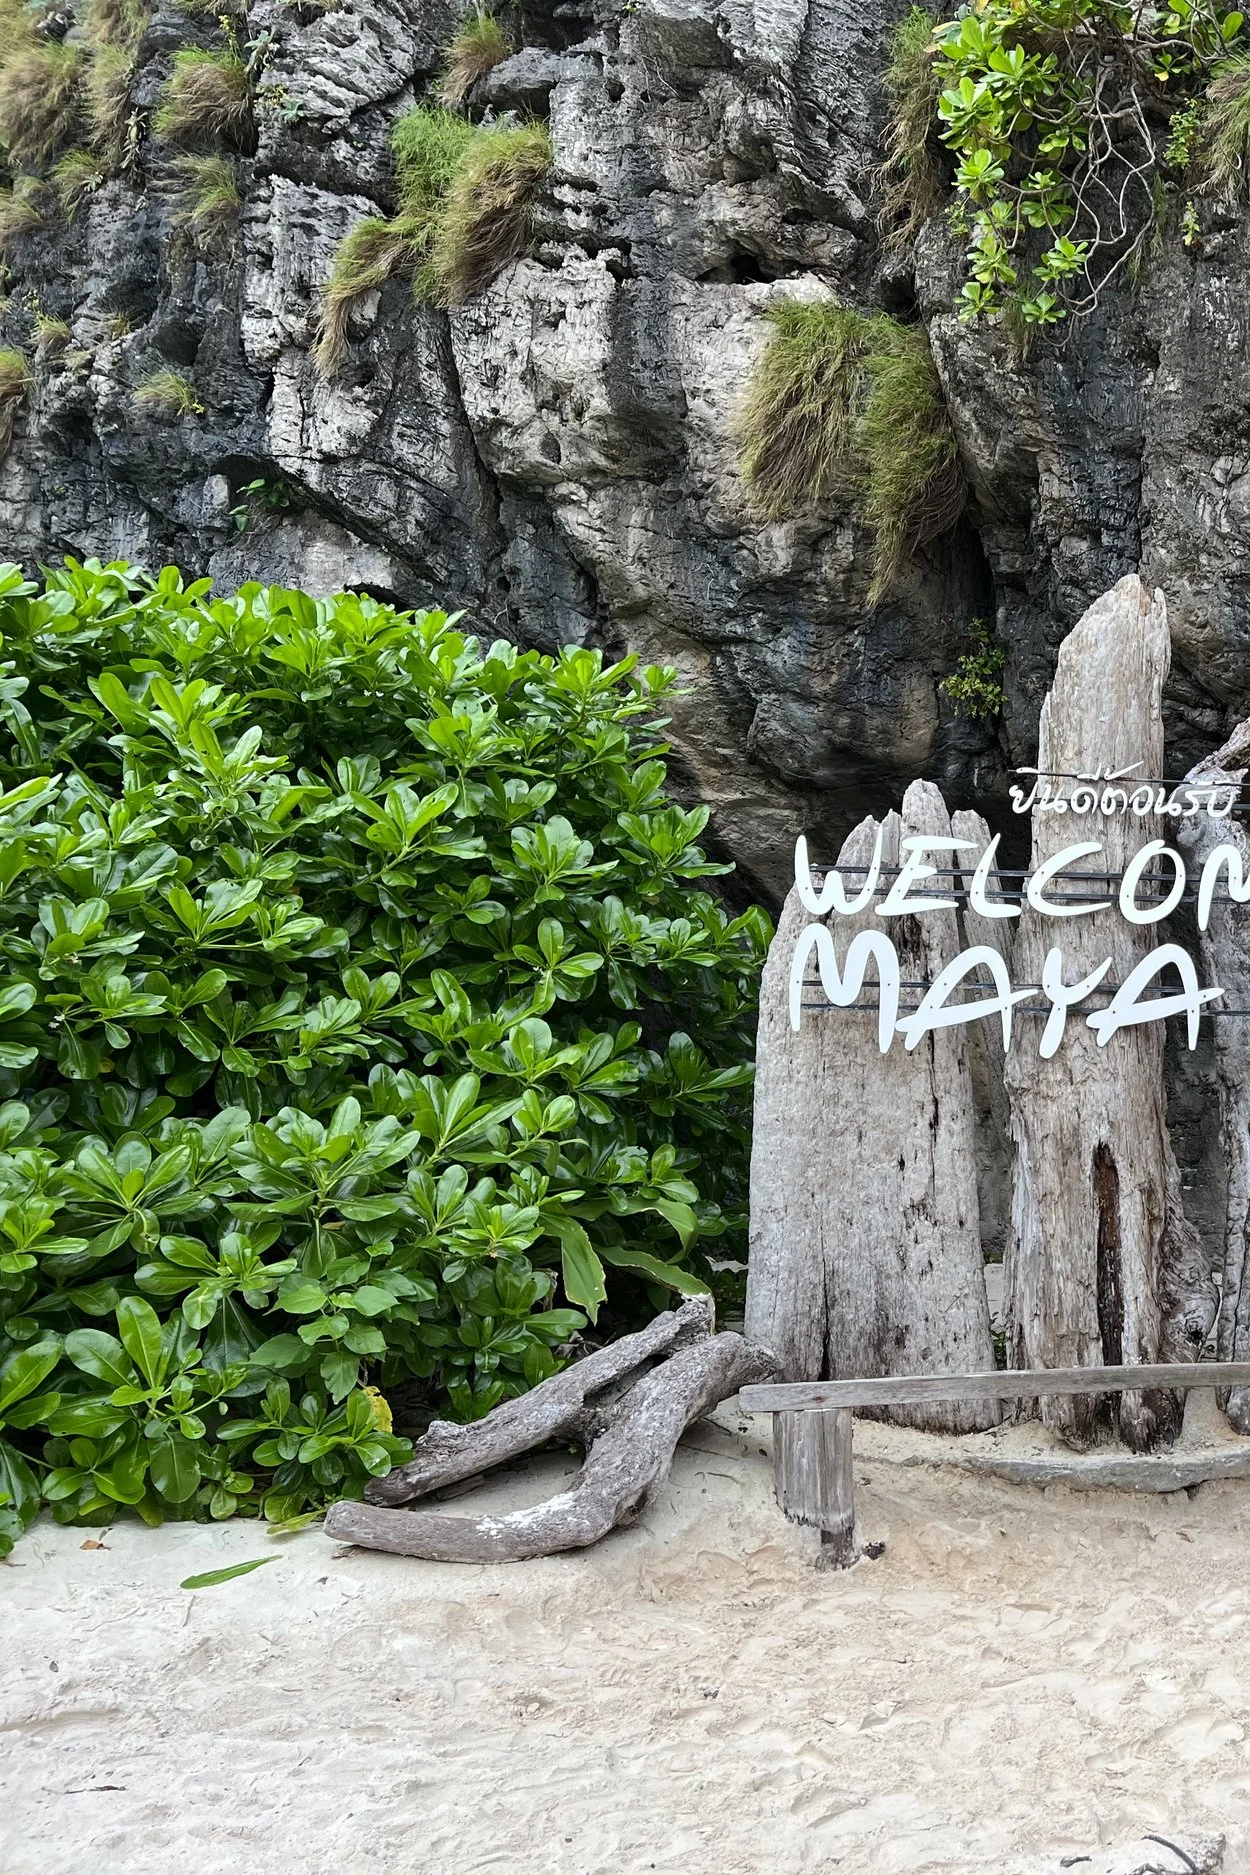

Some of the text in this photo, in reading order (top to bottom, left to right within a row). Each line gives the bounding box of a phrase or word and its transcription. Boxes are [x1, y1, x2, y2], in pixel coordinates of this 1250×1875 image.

[1008, 760, 1235, 818] ยินดีต้อนรับ
[788, 922, 1226, 1059] MAYA
